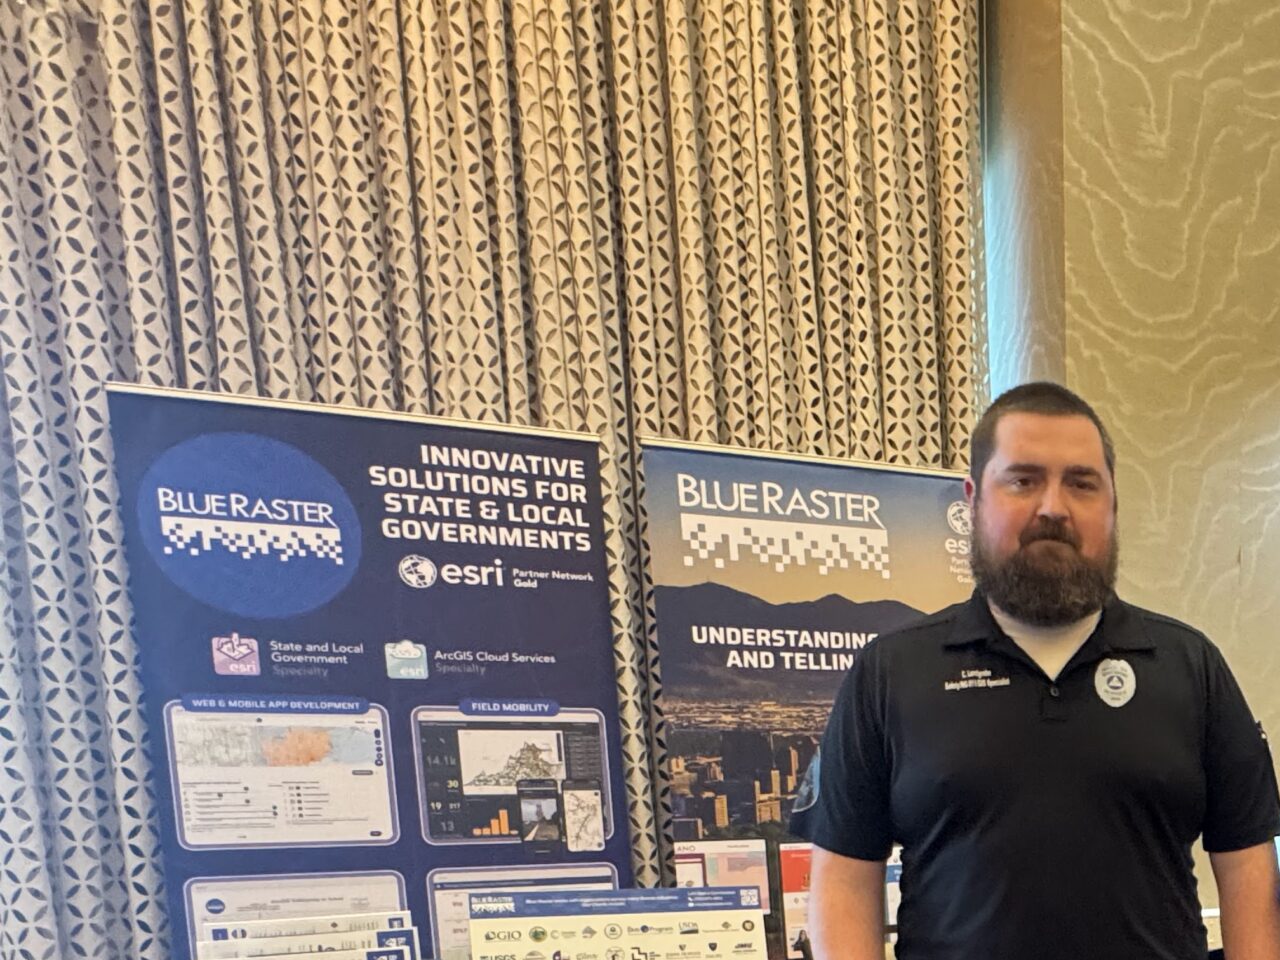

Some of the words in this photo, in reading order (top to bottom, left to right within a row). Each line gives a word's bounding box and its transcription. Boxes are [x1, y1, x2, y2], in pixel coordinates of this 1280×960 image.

[420, 444, 585, 479] INNOVATIVE
[368, 465, 528, 499] SOLUTIONS
[535, 480, 588, 503] FOR
[384, 492, 472, 518] STATE
[479, 500, 500, 520] &
[507, 502, 590, 527] LOCAL
[381, 518, 592, 552] GOVERNMENTS
[441, 559, 504, 587] esri
[512, 568, 549, 579] Partner
[551, 570, 594, 582] Network
[513, 579, 538, 589] Gold
[269, 640, 301, 652] State
[305, 642, 330, 653] and
[332, 643, 364, 654] Local
[271, 652, 348, 664] Government
[434, 650, 473, 661] ArcGIS
[476, 651, 509, 662] Cloud
[512, 652, 556, 663] Services
[726, 651, 775, 669] AND
[779, 651, 854, 671] TELLIN
[192, 699, 216, 707] WEB
[228, 700, 266, 708] MOBILE
[268, 701, 288, 709] APP
[290, 702, 360, 710] DEVELOPMENT
[472, 702, 500, 711] FIELD
[502, 703, 550, 712] MOBILITY
